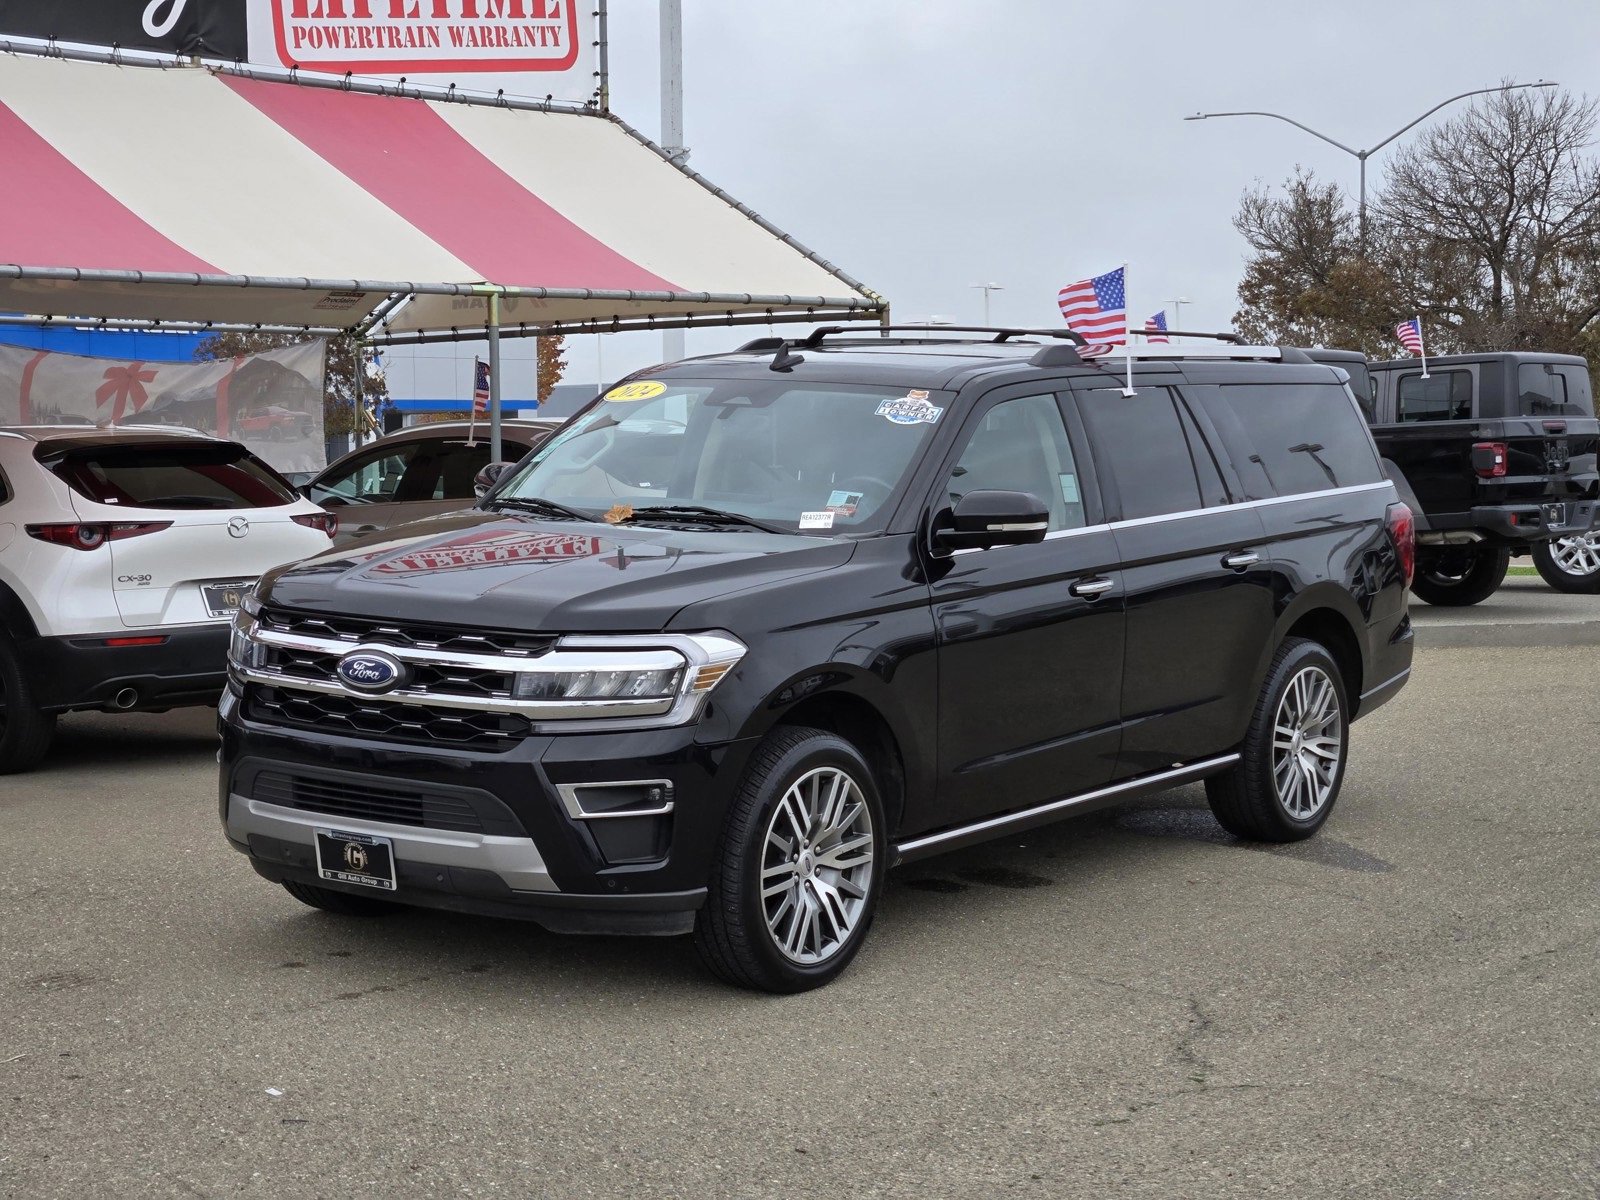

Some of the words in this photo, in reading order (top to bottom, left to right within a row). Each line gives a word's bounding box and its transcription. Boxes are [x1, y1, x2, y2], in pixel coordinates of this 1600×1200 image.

[292, 26, 440, 49] POWERTRAIN
[449, 25, 562, 48] WARRANTY
[884, 402, 938, 415] CARFAX
[117, 574, 152, 583] CX-30
[349, 660, 381, 680] Ford
[348, 874, 361, 882] Auto
[361, 877, 378, 886] Group
